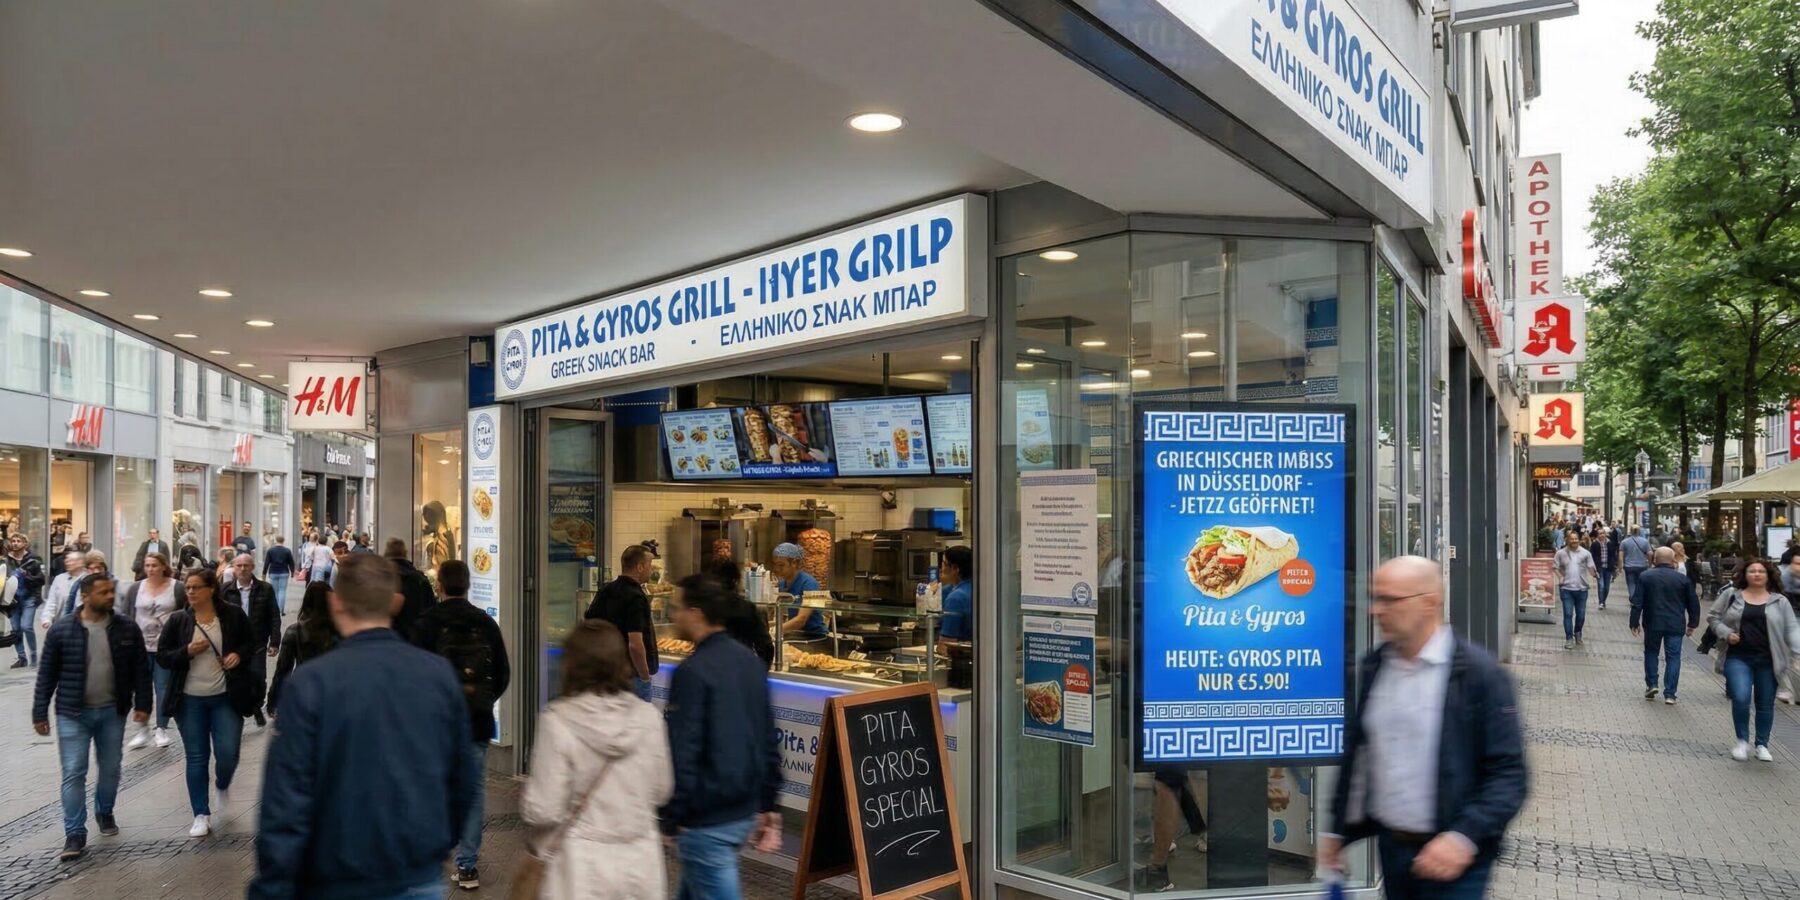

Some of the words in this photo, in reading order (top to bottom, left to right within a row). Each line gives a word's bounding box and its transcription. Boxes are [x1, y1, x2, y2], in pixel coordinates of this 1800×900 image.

[1304, 0, 1373, 103] GYROS
[1378, 68, 1424, 156] GRILL
[1252, 17, 1333, 120] ΕΛΛΗΝΙΚΟ
[1337, 96, 1372, 155] ΣΝΑΚ
[1376, 131, 1408, 182] ΜΠΑΡ
[531, 320, 572, 358] PITA
[575, 314, 590, 349] &
[593, 295, 663, 344] GYROS
[668, 276, 736, 326] GRILL
[848, 217, 953, 283] GRILP
[720, 308, 807, 347] ΕΛΛΗΝΙΚΟ
[812, 294, 867, 328] ΣΝΑΚ
[873, 279, 937, 316] ΜΠΑΡ
[551, 356, 586, 379] GREEK
[588, 349, 627, 372] SNACK
[630, 342, 656, 364] BAR
[294, 376, 361, 417] H&M
[1157, 450, 1273, 469] GRIECHISCHER
[1177, 474, 1195, 491] IN
[1200, 470, 1303, 492] DÜSSELDORF
[1179, 496, 1225, 514] JETZZ
[1229, 493, 1315, 514] GEÖFFNET!
[1183, 604, 1226, 626] Pita
[1230, 609, 1243, 626] &
[1245, 604, 1306, 633] Gyros
[1165, 649, 1224, 668] HEUTE:
[1228, 649, 1282, 668] GYROS
[1286, 648, 1323, 667] PITA
[1198, 672, 1234, 691] NUR
[1237, 672, 1290, 691] €5.90!
[861, 710, 916, 745] PITA
[860, 747, 930, 785] GYROS
[864, 786, 945, 828] SPECIAL
